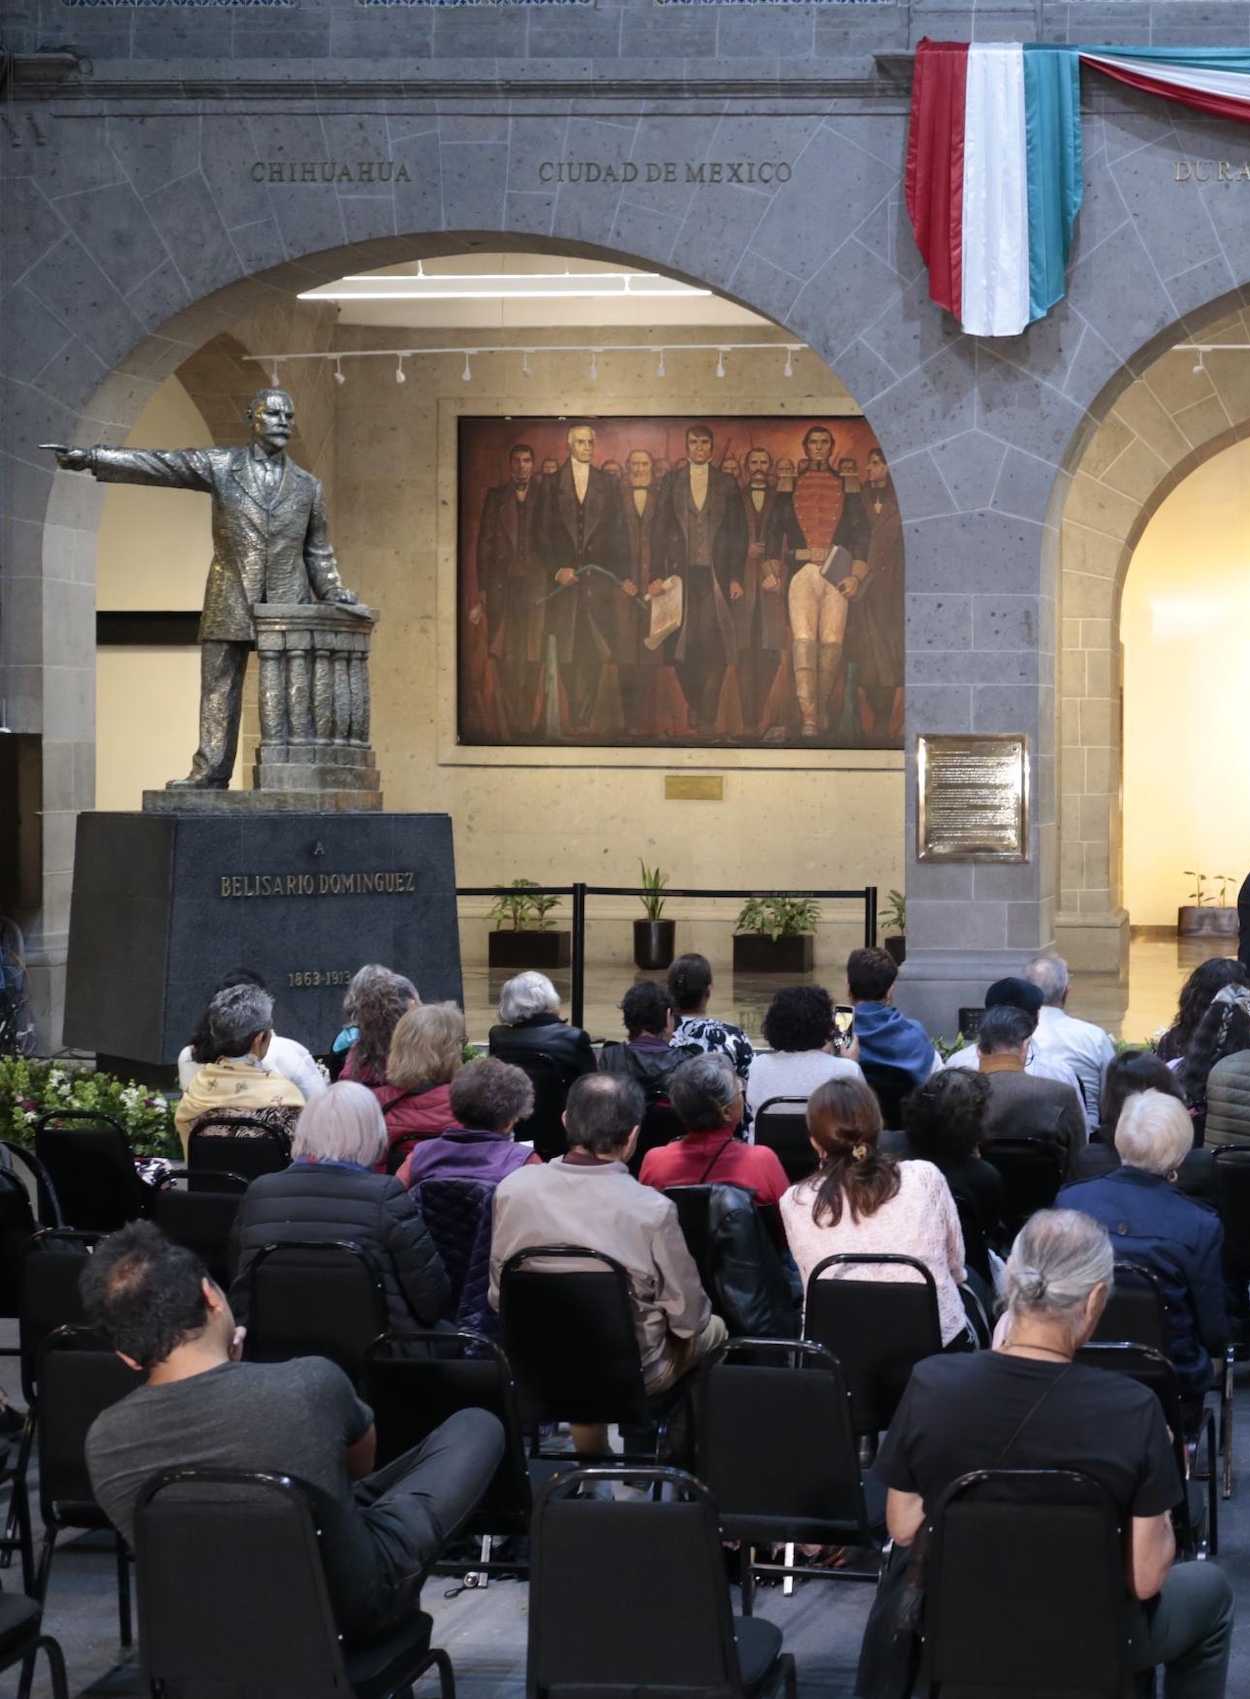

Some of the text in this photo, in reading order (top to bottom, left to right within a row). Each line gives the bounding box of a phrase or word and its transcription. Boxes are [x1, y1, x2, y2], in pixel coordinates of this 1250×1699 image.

[250, 161, 413, 183] CHIHUAHUA
[538, 161, 793, 183] CIUDAD DE MEXICO
[313, 841, 326, 855] A
[220, 871, 416, 898] BELISARIO DOMINGUEZ
[288, 970, 350, 988] 1863-1913
